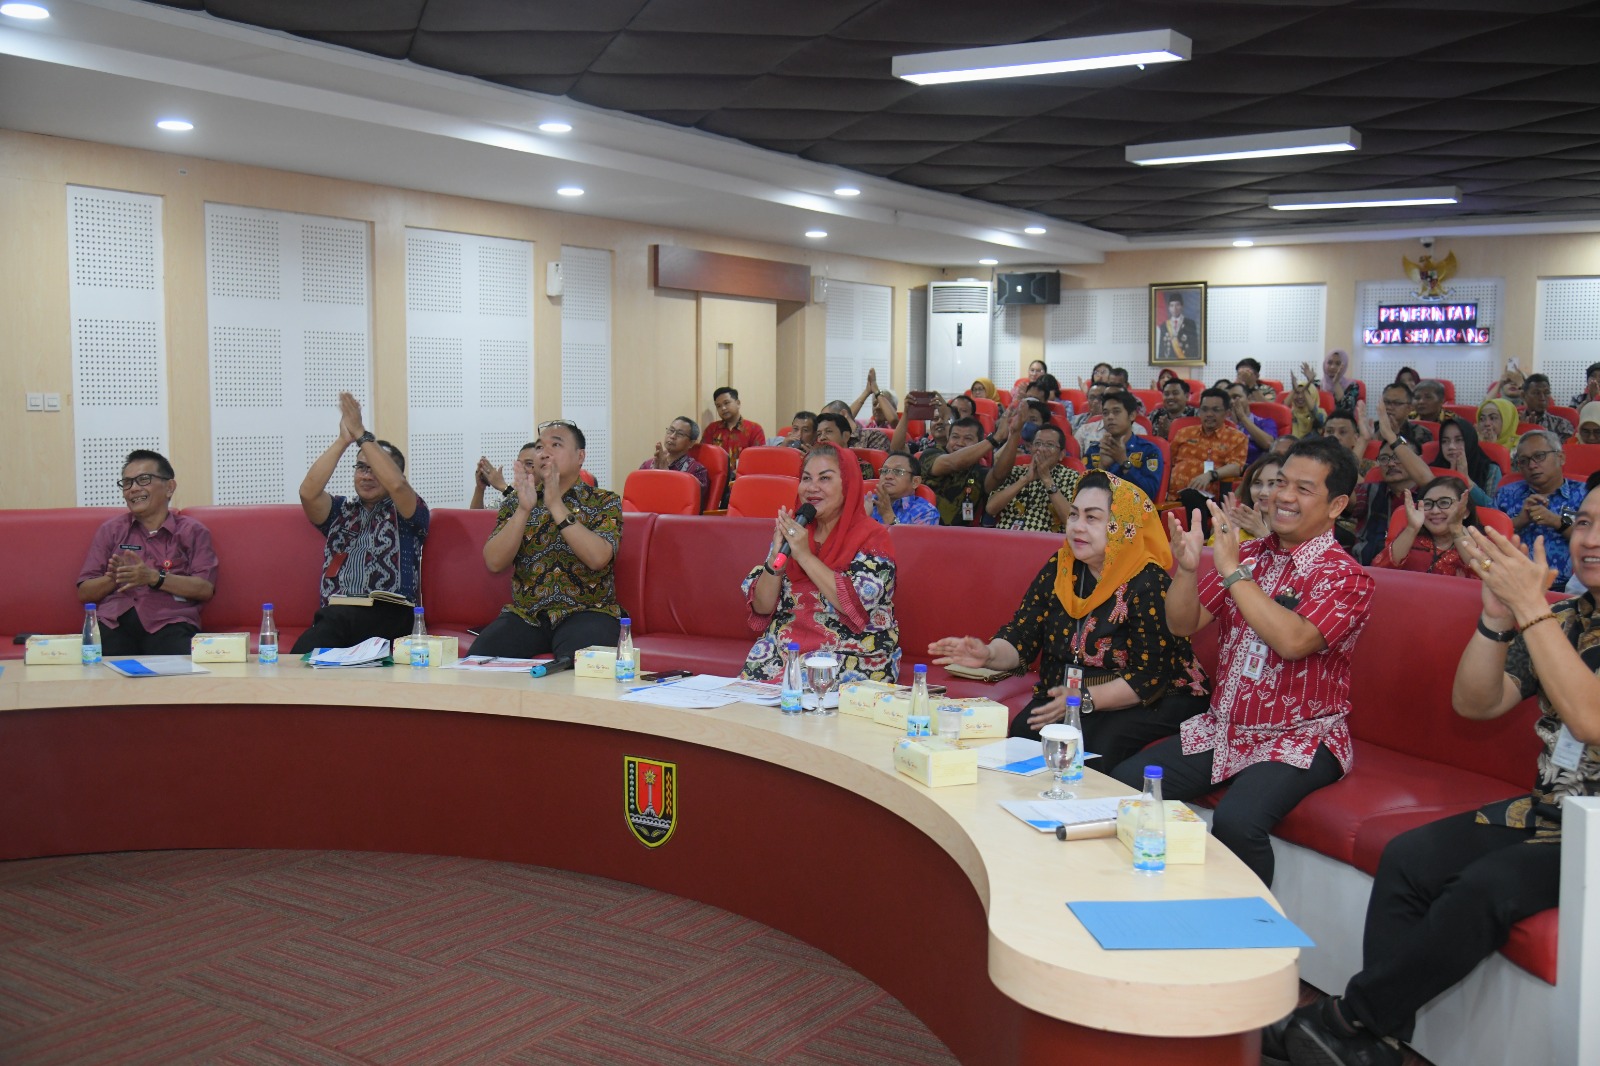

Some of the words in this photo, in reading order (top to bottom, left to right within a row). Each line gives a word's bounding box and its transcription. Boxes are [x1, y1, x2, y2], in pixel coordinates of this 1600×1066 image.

[1380, 306, 1476, 322] PEMERINTAH
[1364, 329, 1402, 344] KOTA
[1405, 328, 1488, 343] SEMARANG
